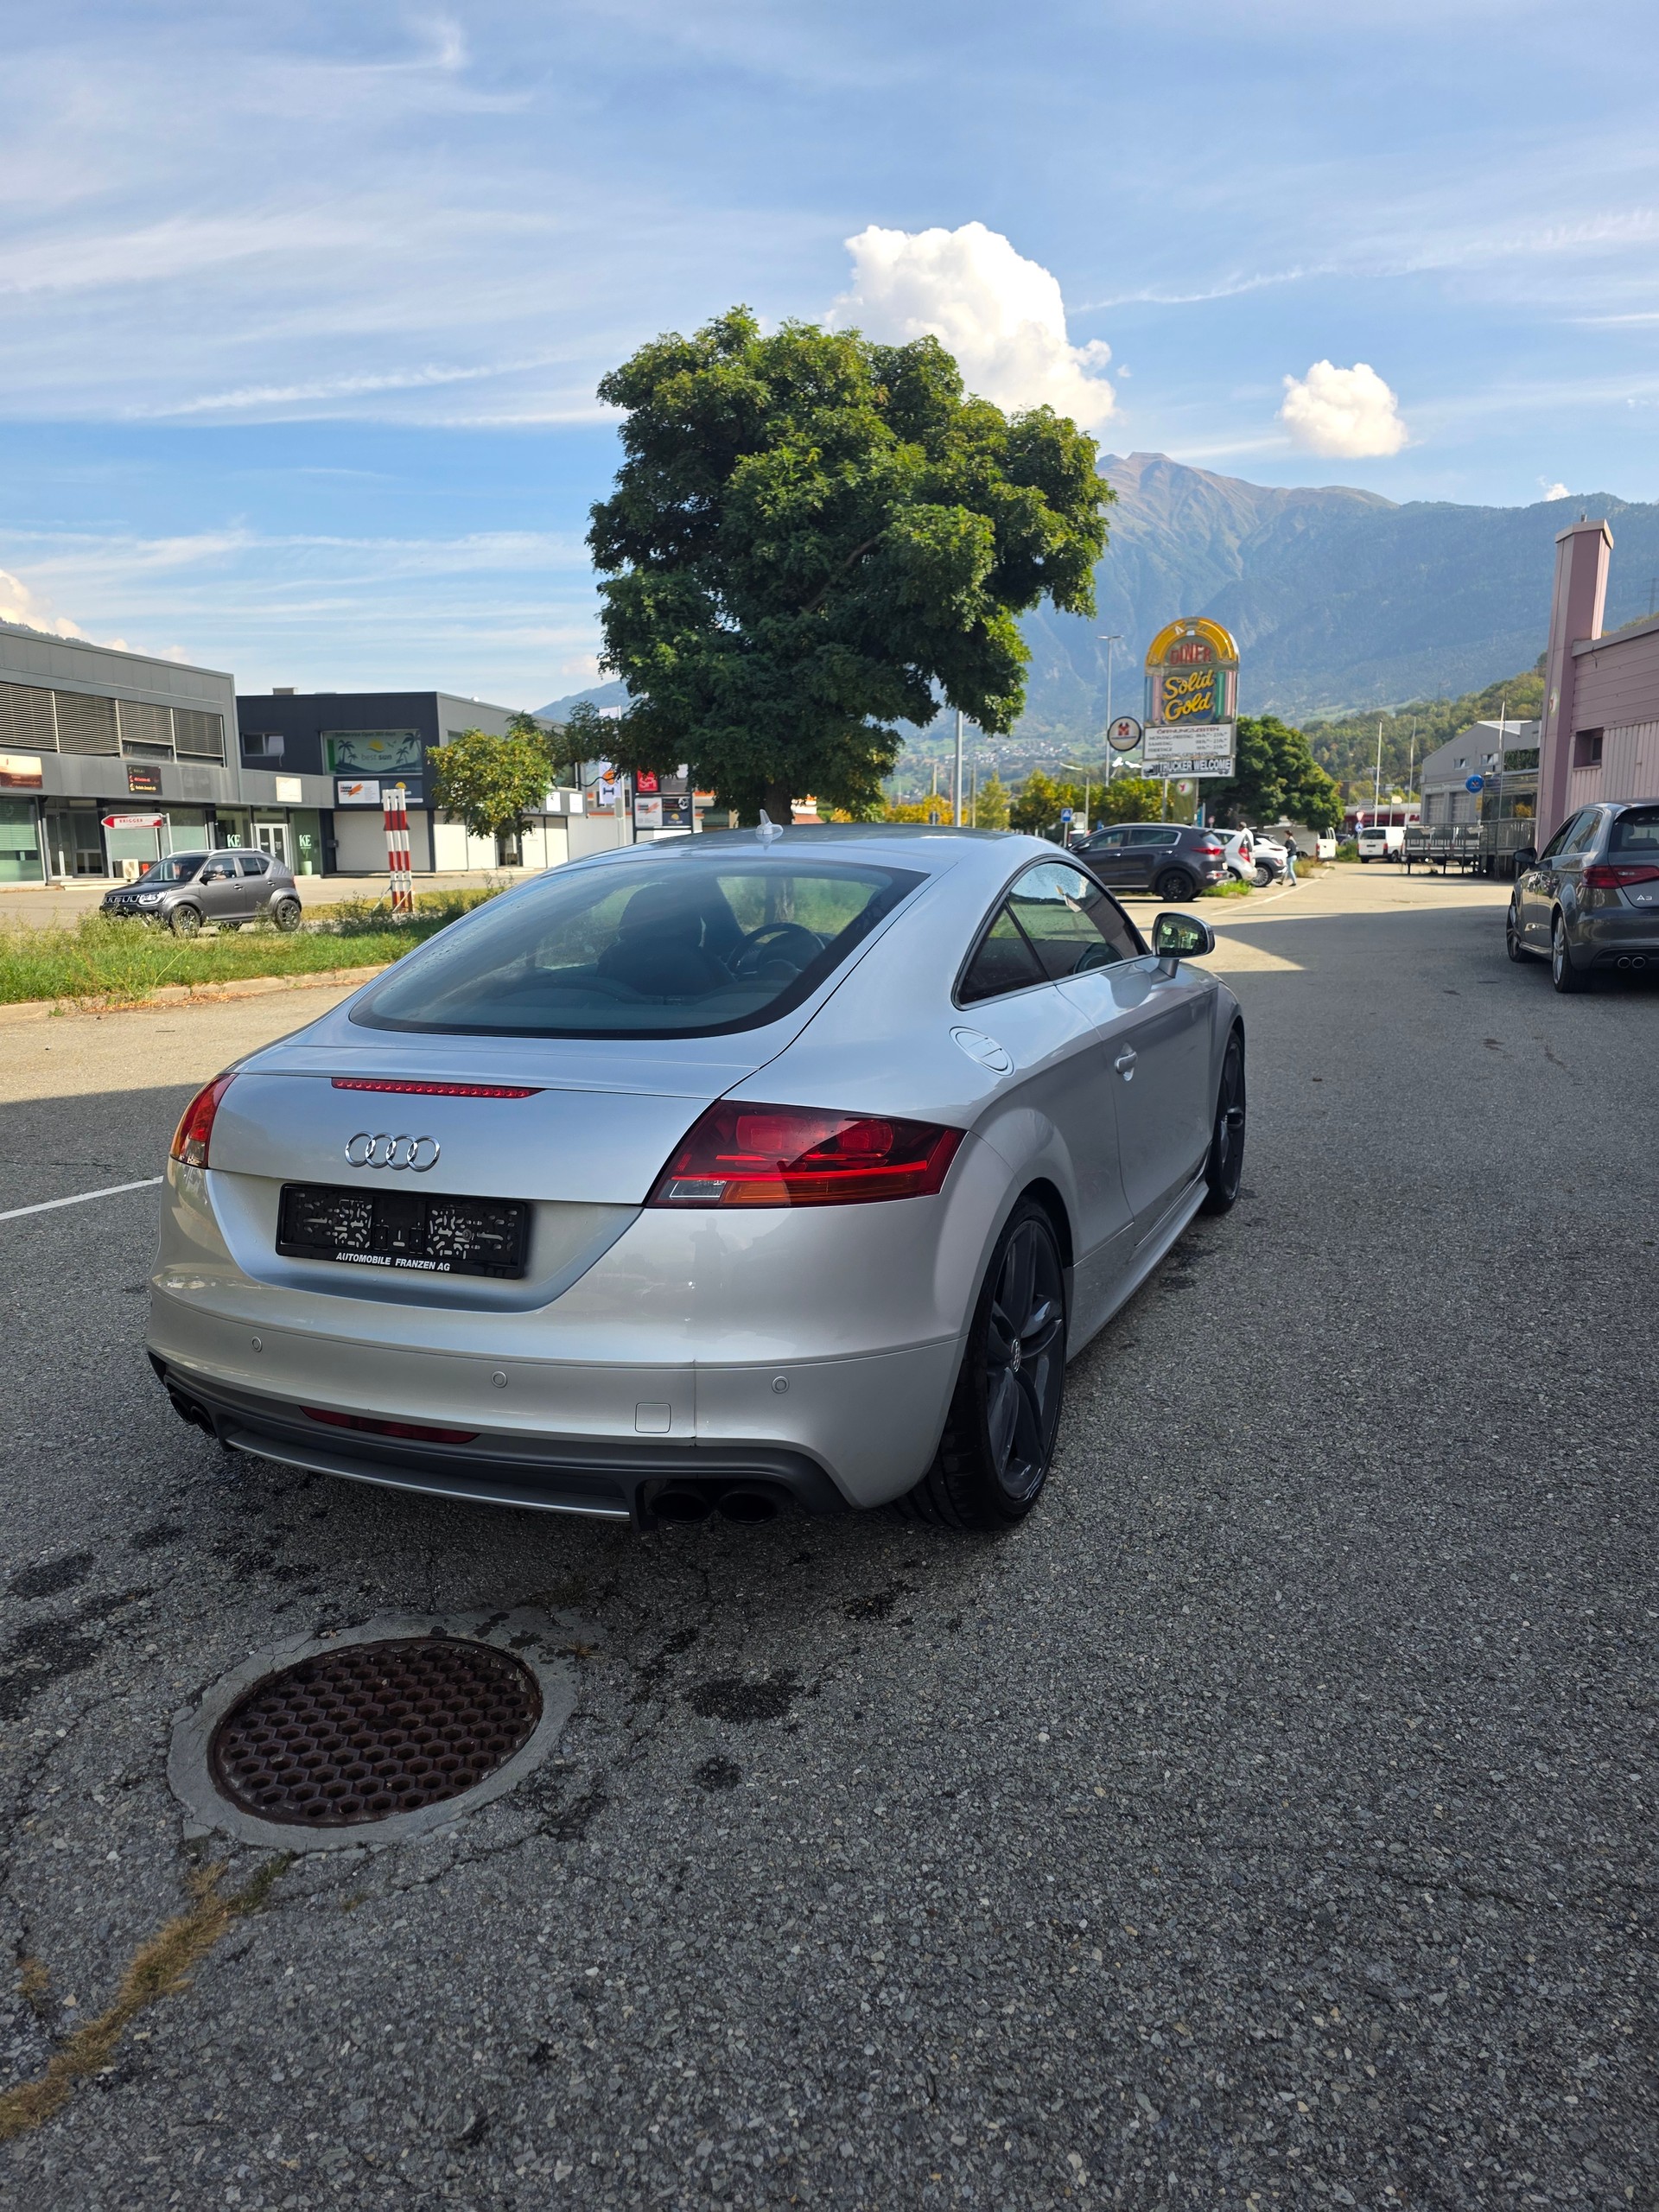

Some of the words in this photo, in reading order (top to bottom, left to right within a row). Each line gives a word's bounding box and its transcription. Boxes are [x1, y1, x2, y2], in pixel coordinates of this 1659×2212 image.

[1170, 644, 1211, 664] DINER
[1163, 670, 1213, 700] Solid
[1165, 692, 1211, 721] Gold
[1159, 760, 1192, 772] TRUCKER
[1192, 759, 1231, 771] WELCOME
[227, 835, 241, 847] KE
[299, 835, 312, 847] KE
[336, 1252, 391, 1265] AUTOMOBILE
[395, 1258, 435, 1270] FRANZEN
[436, 1262, 451, 1272] AG
